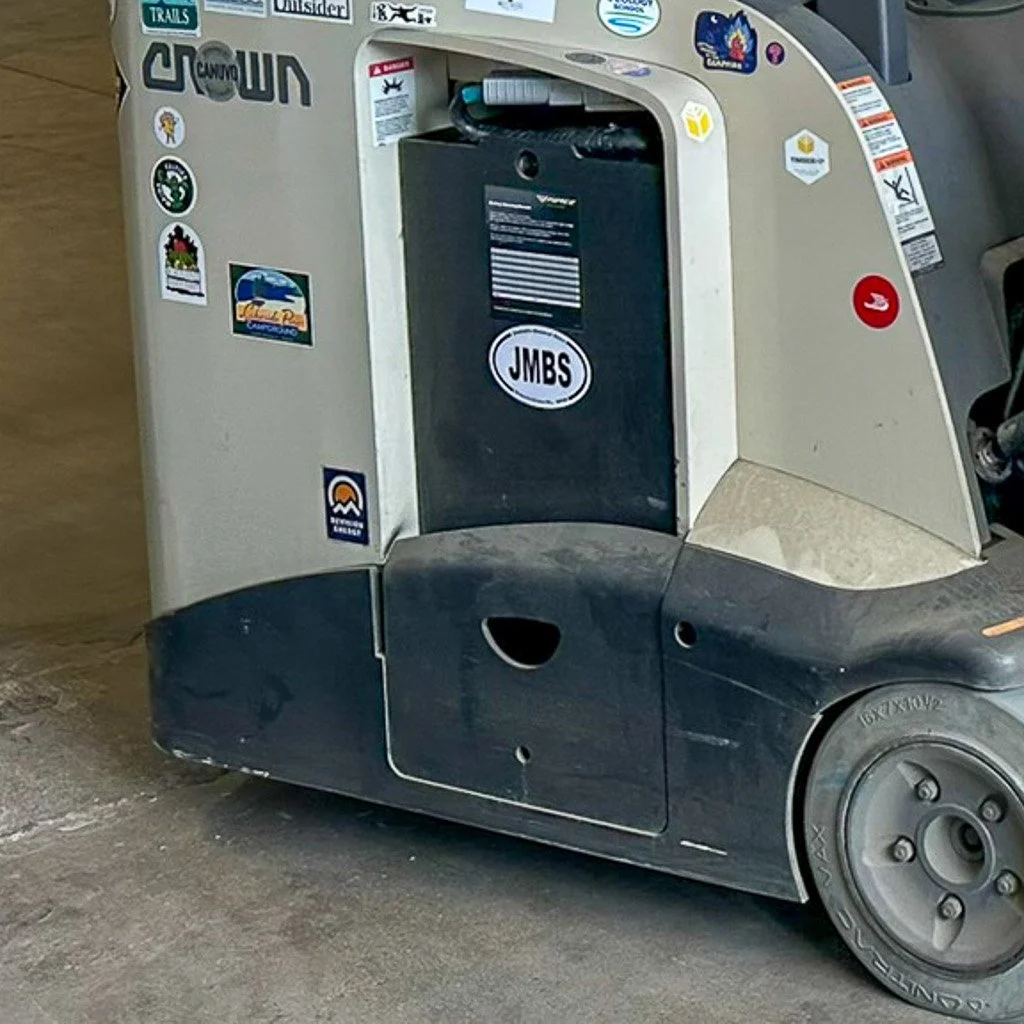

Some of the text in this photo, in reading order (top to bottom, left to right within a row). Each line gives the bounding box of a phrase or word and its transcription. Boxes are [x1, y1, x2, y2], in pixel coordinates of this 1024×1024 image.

[149, 6, 190, 25] TRAILS
[142, 42, 312, 108] CRWN
[508, 346, 572, 389] JMBS
